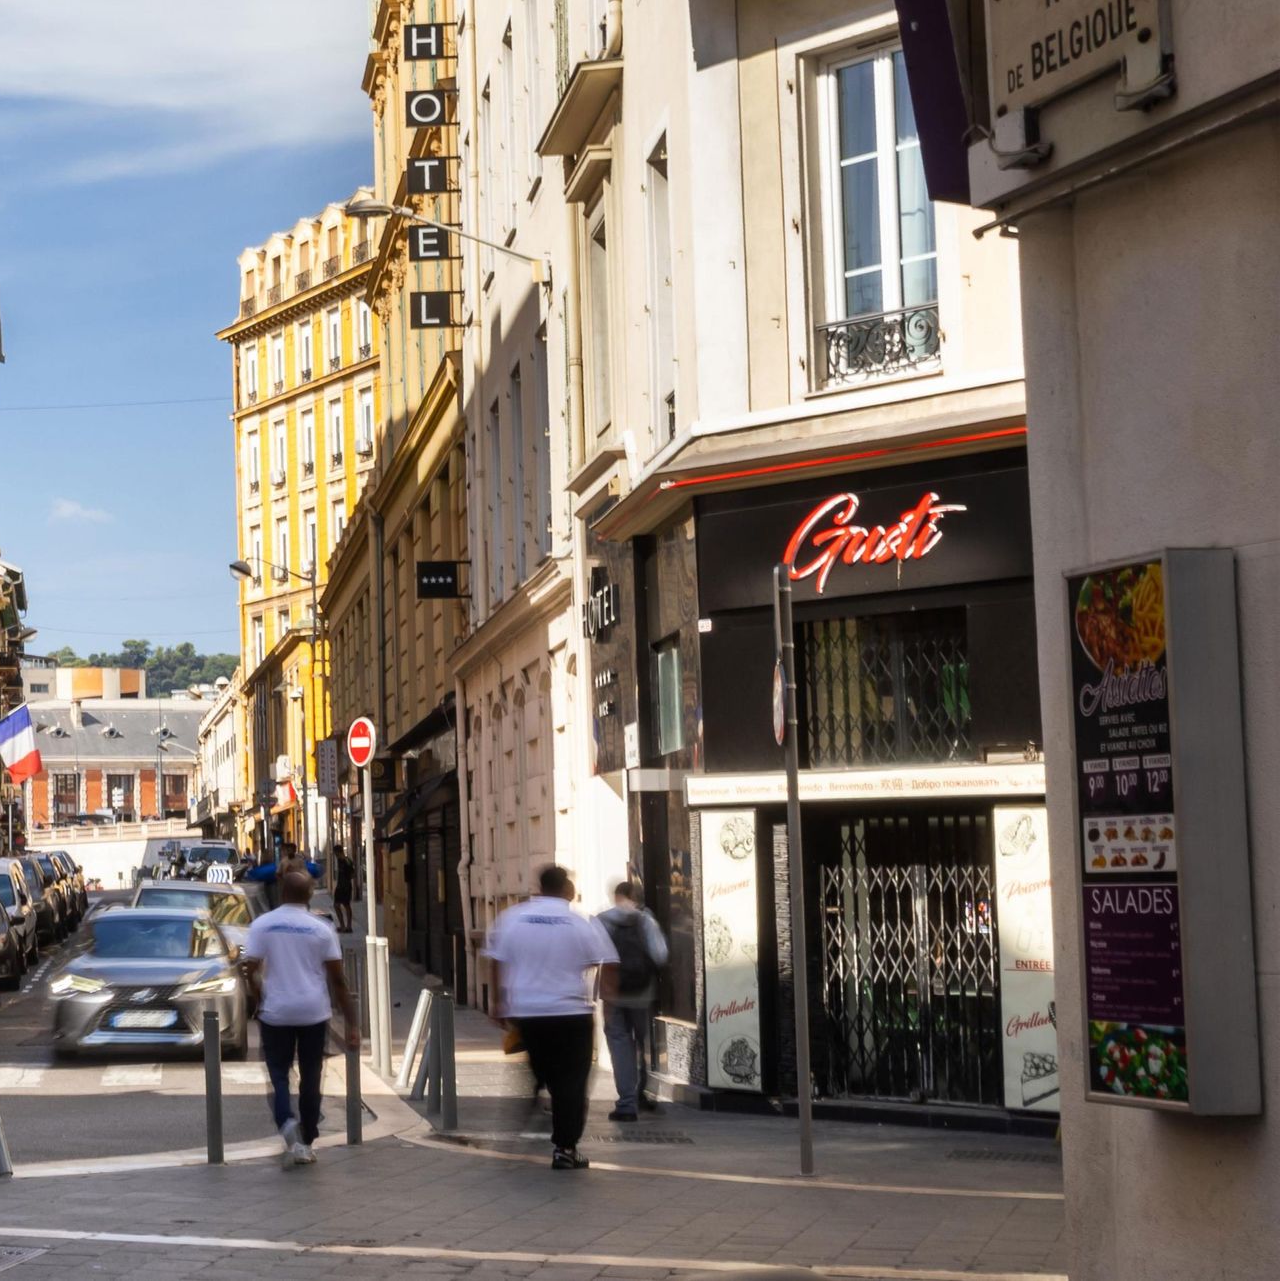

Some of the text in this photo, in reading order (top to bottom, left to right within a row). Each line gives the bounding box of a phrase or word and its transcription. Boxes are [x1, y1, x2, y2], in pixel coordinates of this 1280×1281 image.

[1007, 63, 1025, 94] DE
[411, 27, 439, 324] HOTEL
[783, 492, 967, 594] Gusti
[583, 583, 617, 640] HOTEL
[1080, 656, 1168, 717] Assiettes
[1137, 739, 1156, 750] CHOIX
[911, 779, 941, 791] Добро
[1092, 889, 1172, 914] SALADES
[709, 997, 756, 1024] Grillades
